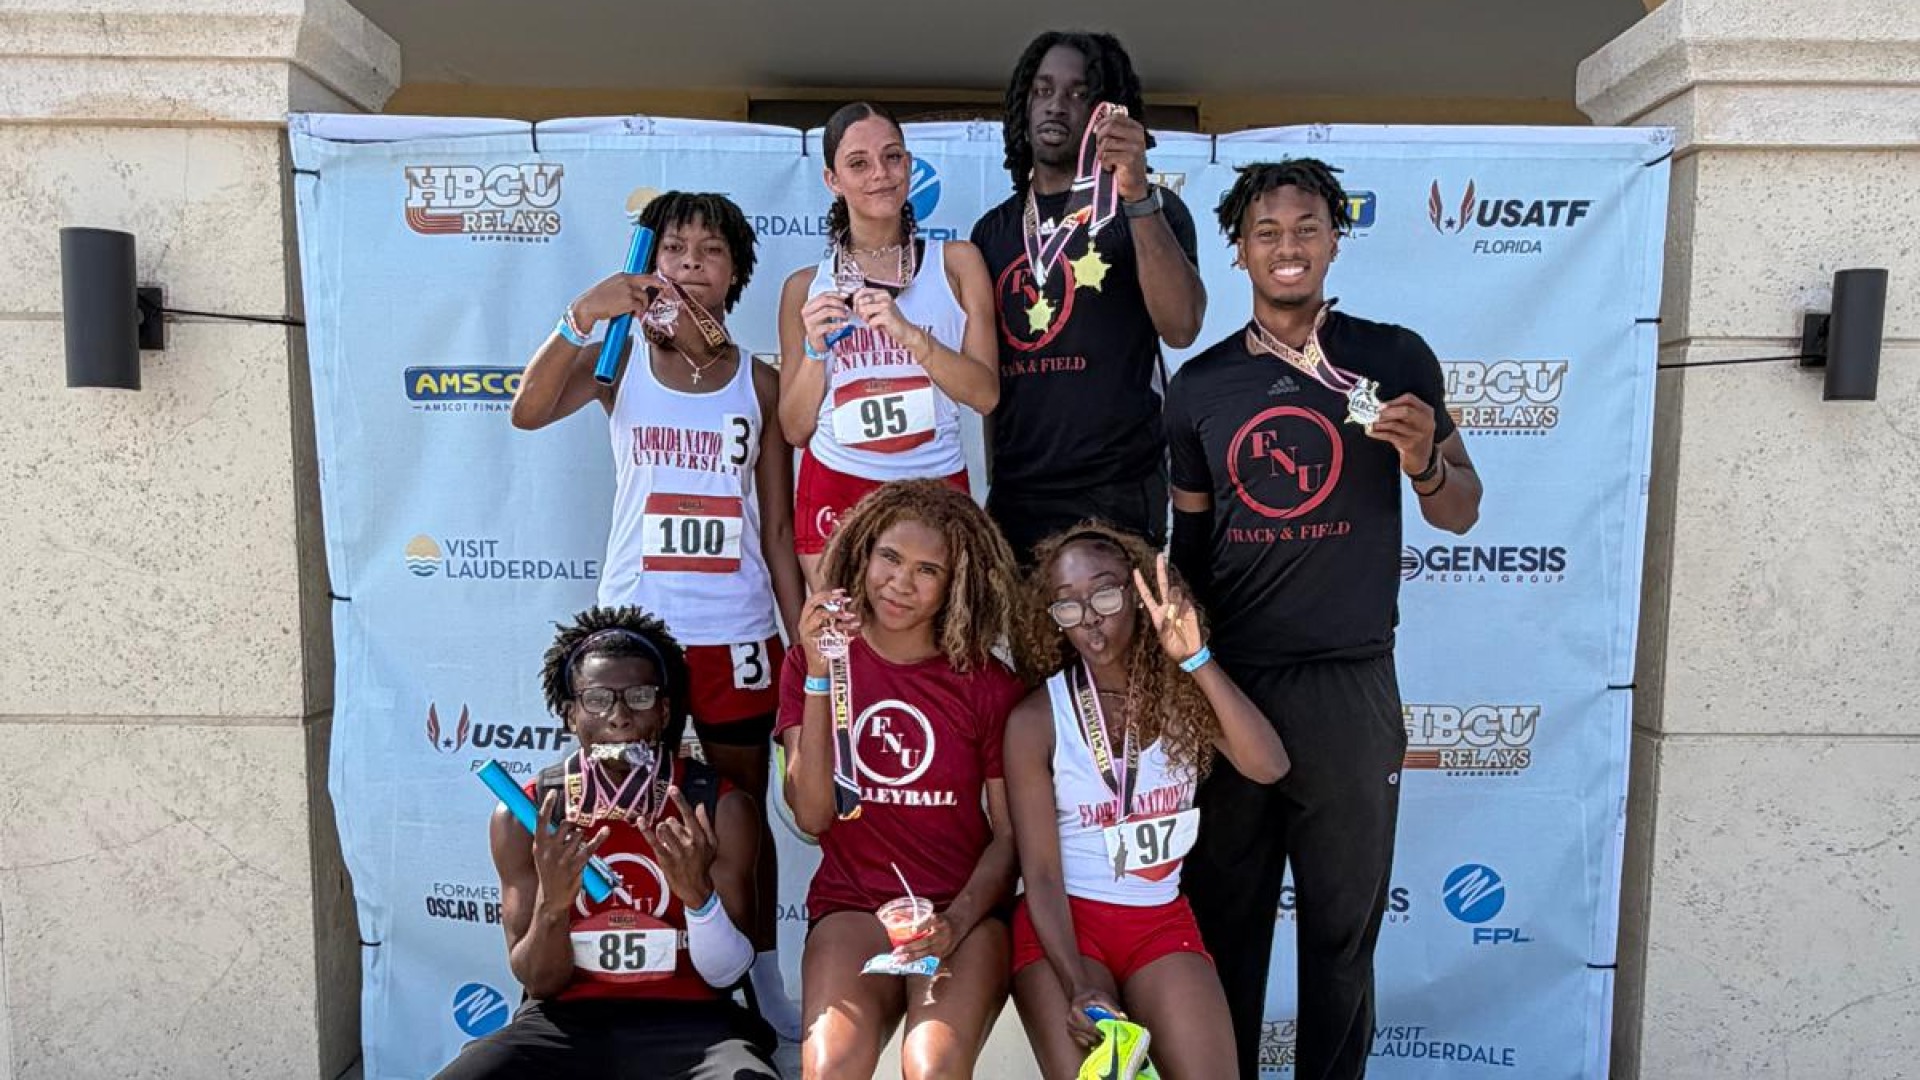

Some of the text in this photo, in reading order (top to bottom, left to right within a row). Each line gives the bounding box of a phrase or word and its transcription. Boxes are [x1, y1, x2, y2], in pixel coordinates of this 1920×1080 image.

[405, 164, 563, 208] HBCU
[462, 211, 560, 234] RELAYS
[1477, 200, 1591, 227] USATF
[1473, 240, 1542, 254] FLORIDA
[832, 349, 914, 374] UNIVERSI
[1041, 356, 1087, 374] FIELD
[415, 373, 526, 394] AMSCO
[424, 403, 467, 411] AMSCOT
[861, 395, 908, 439] 95
[1460, 406, 1558, 427] RELAYS
[731, 417, 750, 466] 3
[1250, 430, 1324, 492] FNU
[660, 517, 725, 555] 100
[1227, 521, 1351, 545] TRACK & FIELD
[446, 540, 499, 556] VISIT
[1425, 546, 1567, 572] GENESIS
[446, 560, 598, 580] LAUDERDALE
[1426, 574, 1565, 583] MEDIA GROUP
[739, 641, 763, 685] 3
[472, 723, 572, 750] USATF
[871, 716, 922, 769] FNU
[1438, 749, 1532, 768] RELAYS
[1136, 818, 1177, 864] 97
[426, 897, 479, 922] OSCAR
[1473, 927, 1531, 945] FPL
[600, 933, 646, 970] 85
